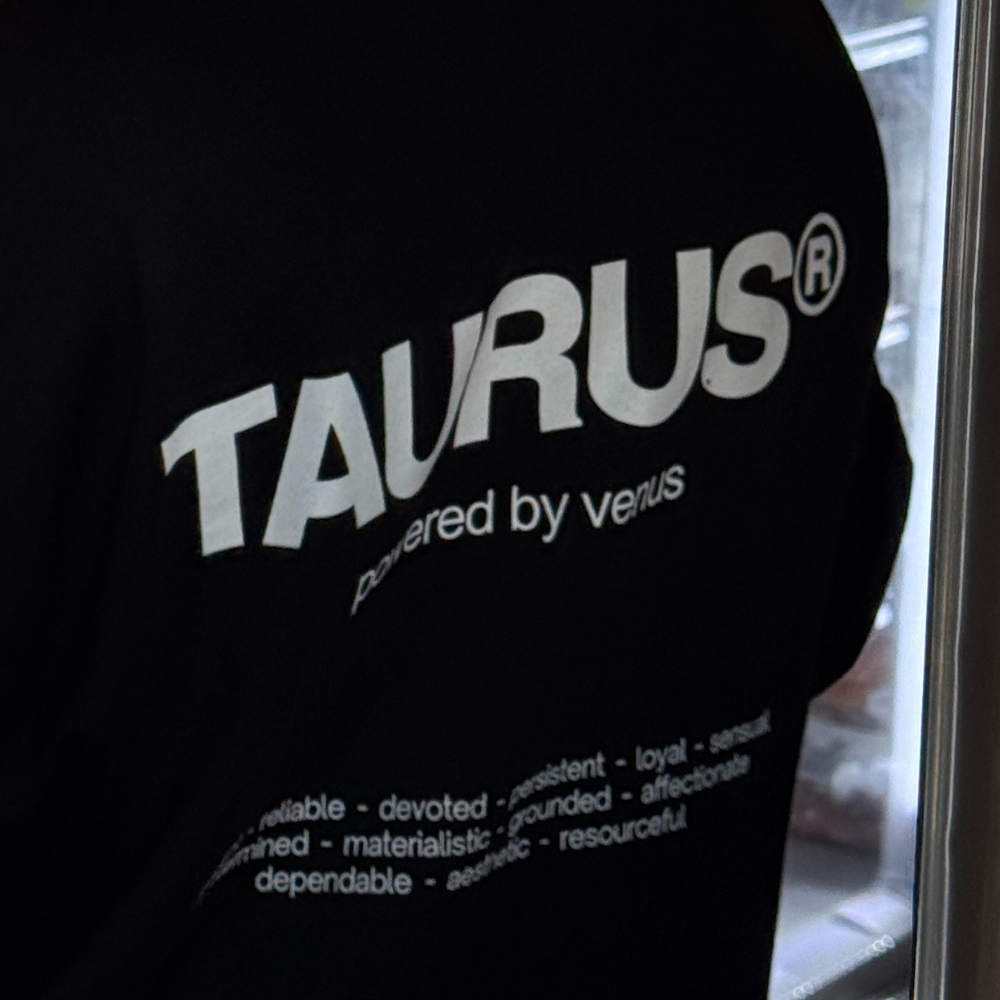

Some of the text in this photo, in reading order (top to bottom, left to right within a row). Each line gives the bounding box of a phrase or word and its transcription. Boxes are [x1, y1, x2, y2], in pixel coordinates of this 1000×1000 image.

[350, 463, 687, 617] powered by venus
[259, 793, 346, 831] reliable
[378, 793, 489, 823] devoted
[507, 751, 607, 811] persistent
[635, 737, 688, 773] loyal
[342, 825, 492, 858] materialistic
[507, 784, 613, 838] grounded
[640, 751, 752, 805] affectionate
[254, 865, 413, 899] dependable
[559, 803, 689, 852] resourceful
